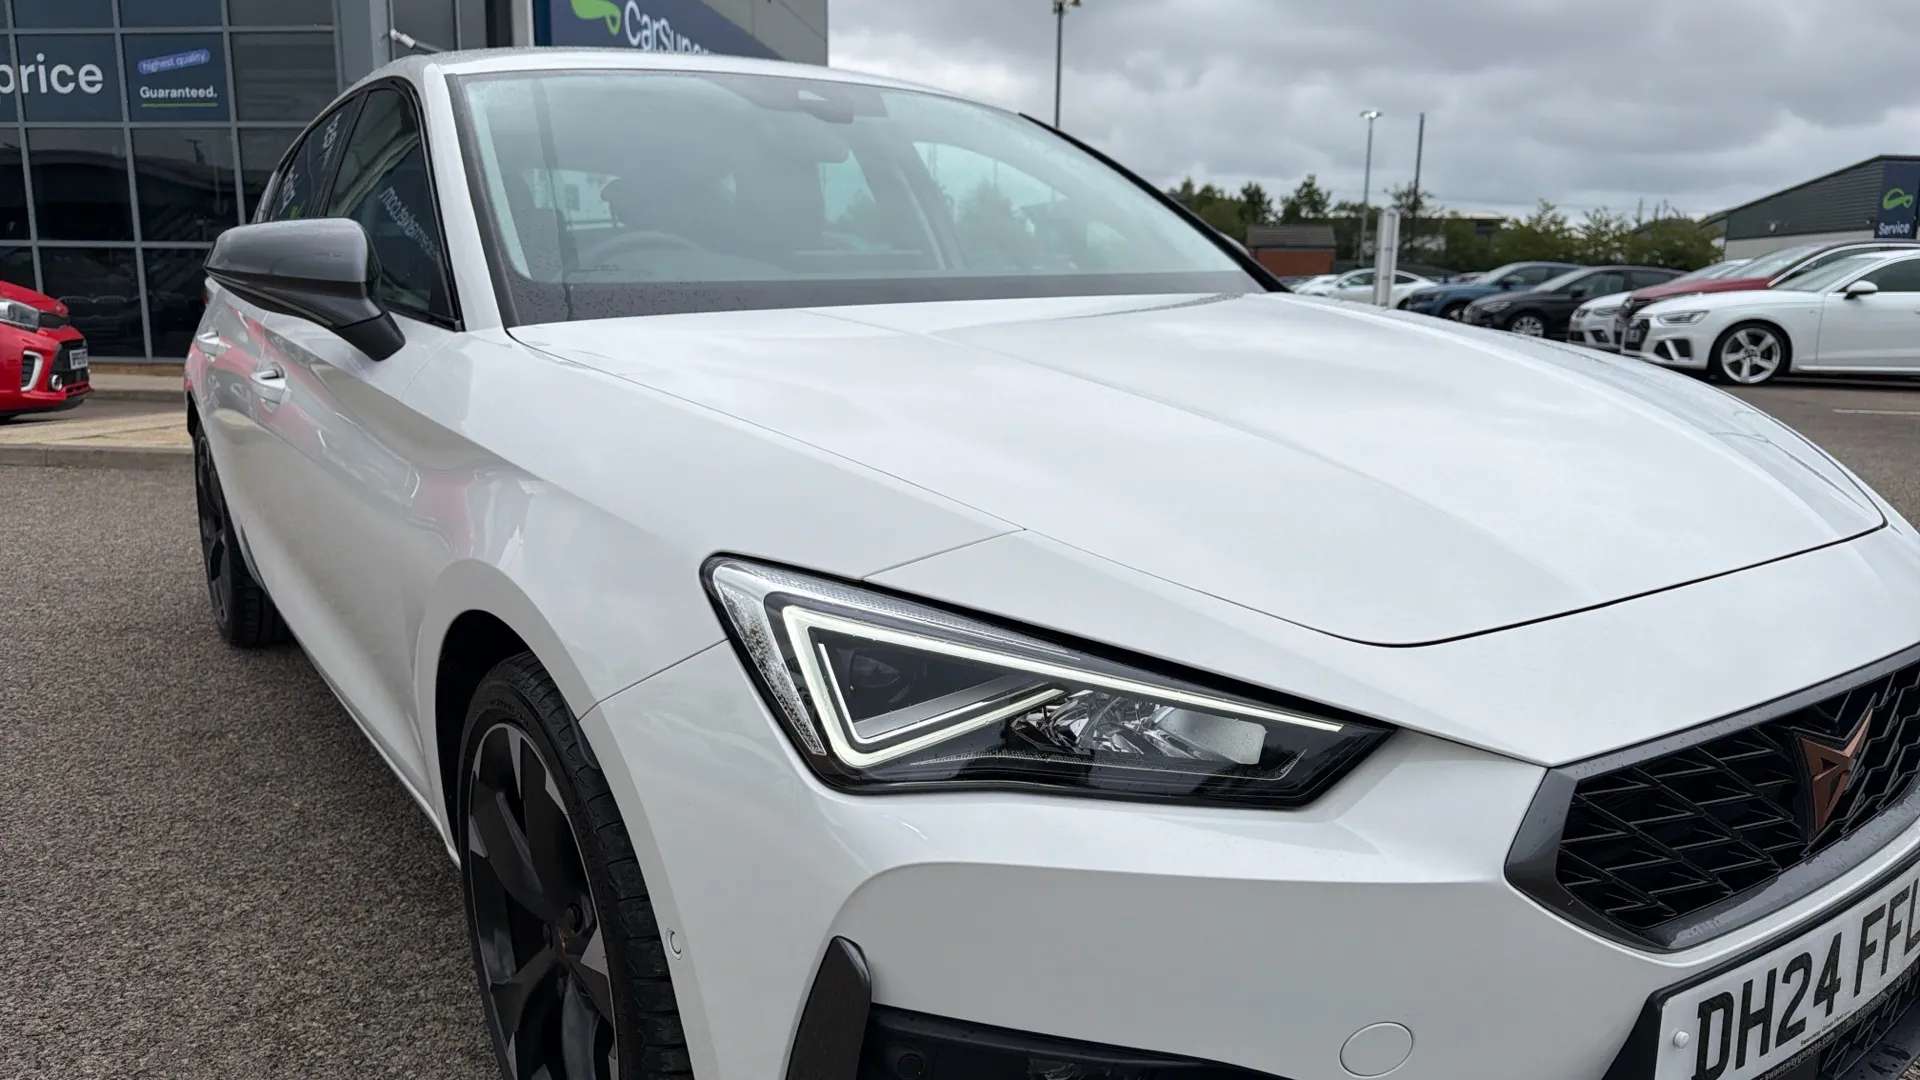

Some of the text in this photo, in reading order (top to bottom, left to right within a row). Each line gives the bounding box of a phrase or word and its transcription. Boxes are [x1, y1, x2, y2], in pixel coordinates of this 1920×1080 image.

[624, 0, 711, 54] CarSup
[140, 85, 218, 98] Guaranteed.
[1879, 222, 1910, 236] Service
[1691, 931, 1843, 1080] DH24
[1853, 878, 1920, 998] FFL
